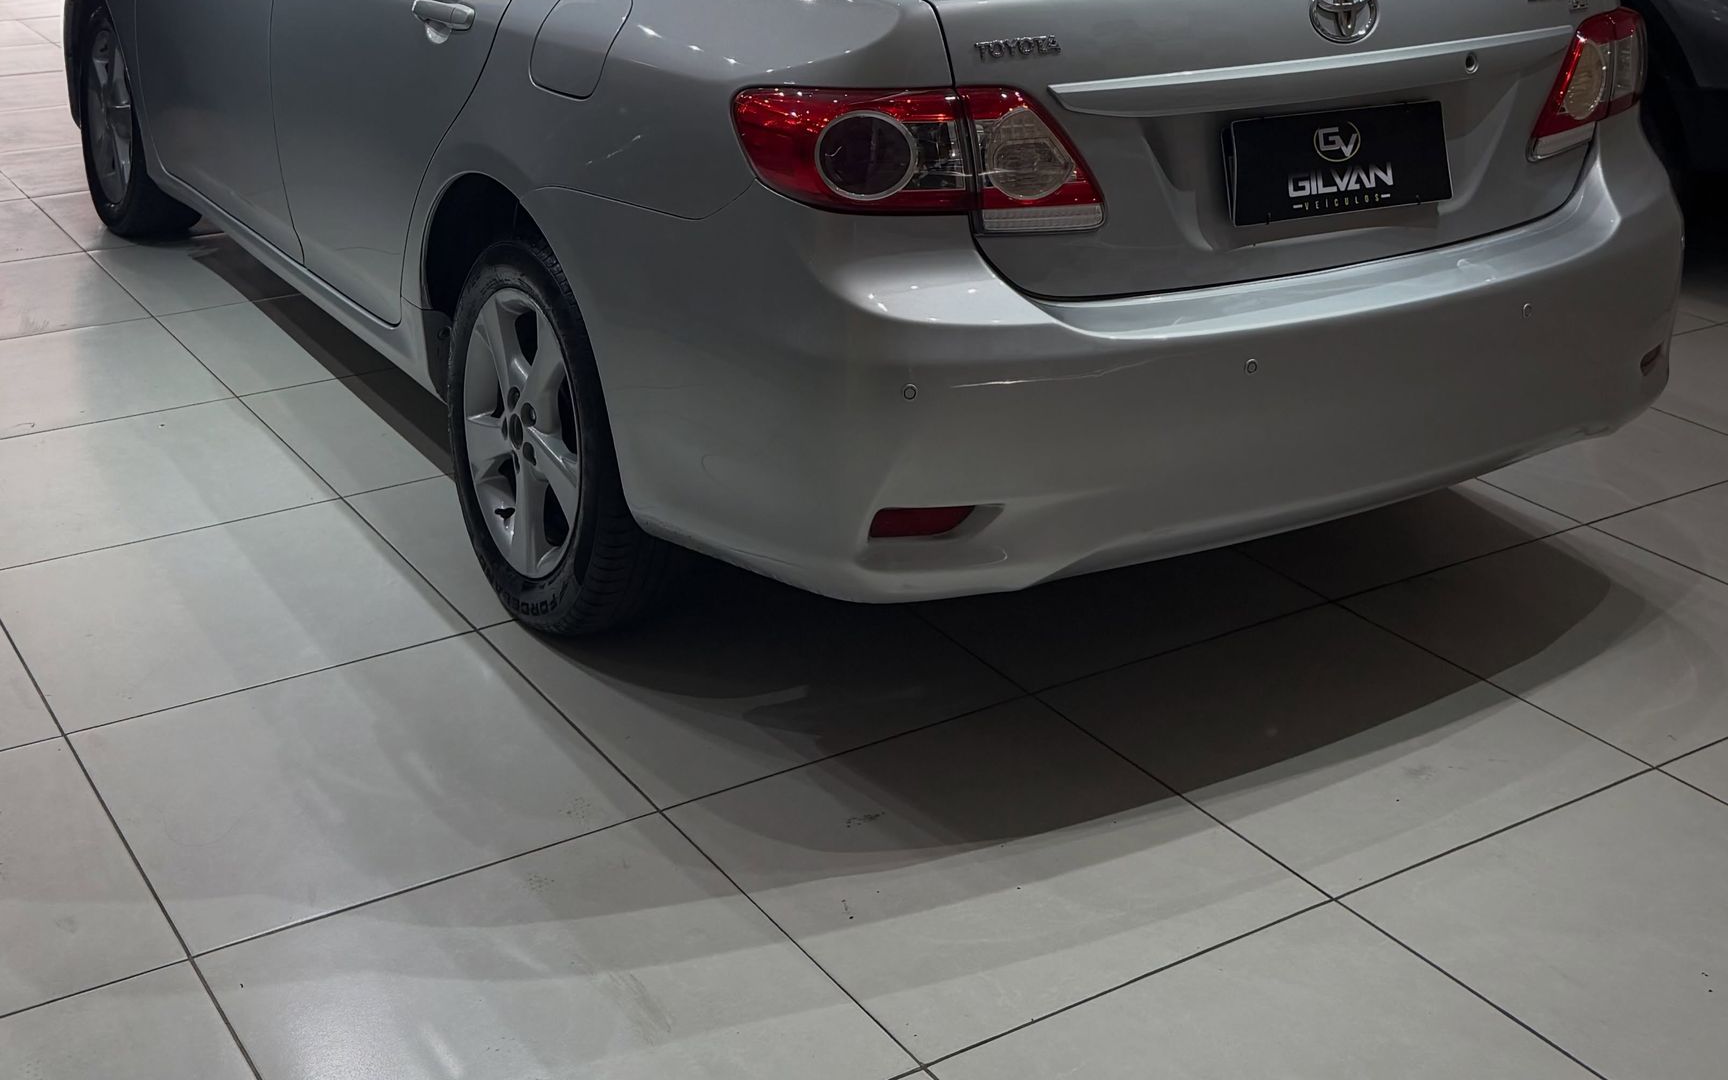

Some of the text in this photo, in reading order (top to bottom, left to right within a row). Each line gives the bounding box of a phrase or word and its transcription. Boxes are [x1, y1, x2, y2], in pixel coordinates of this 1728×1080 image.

[974, 34, 1062, 61] TOYOTA
[1318, 126, 1358, 157] GV
[1287, 161, 1394, 198] GILVAN
